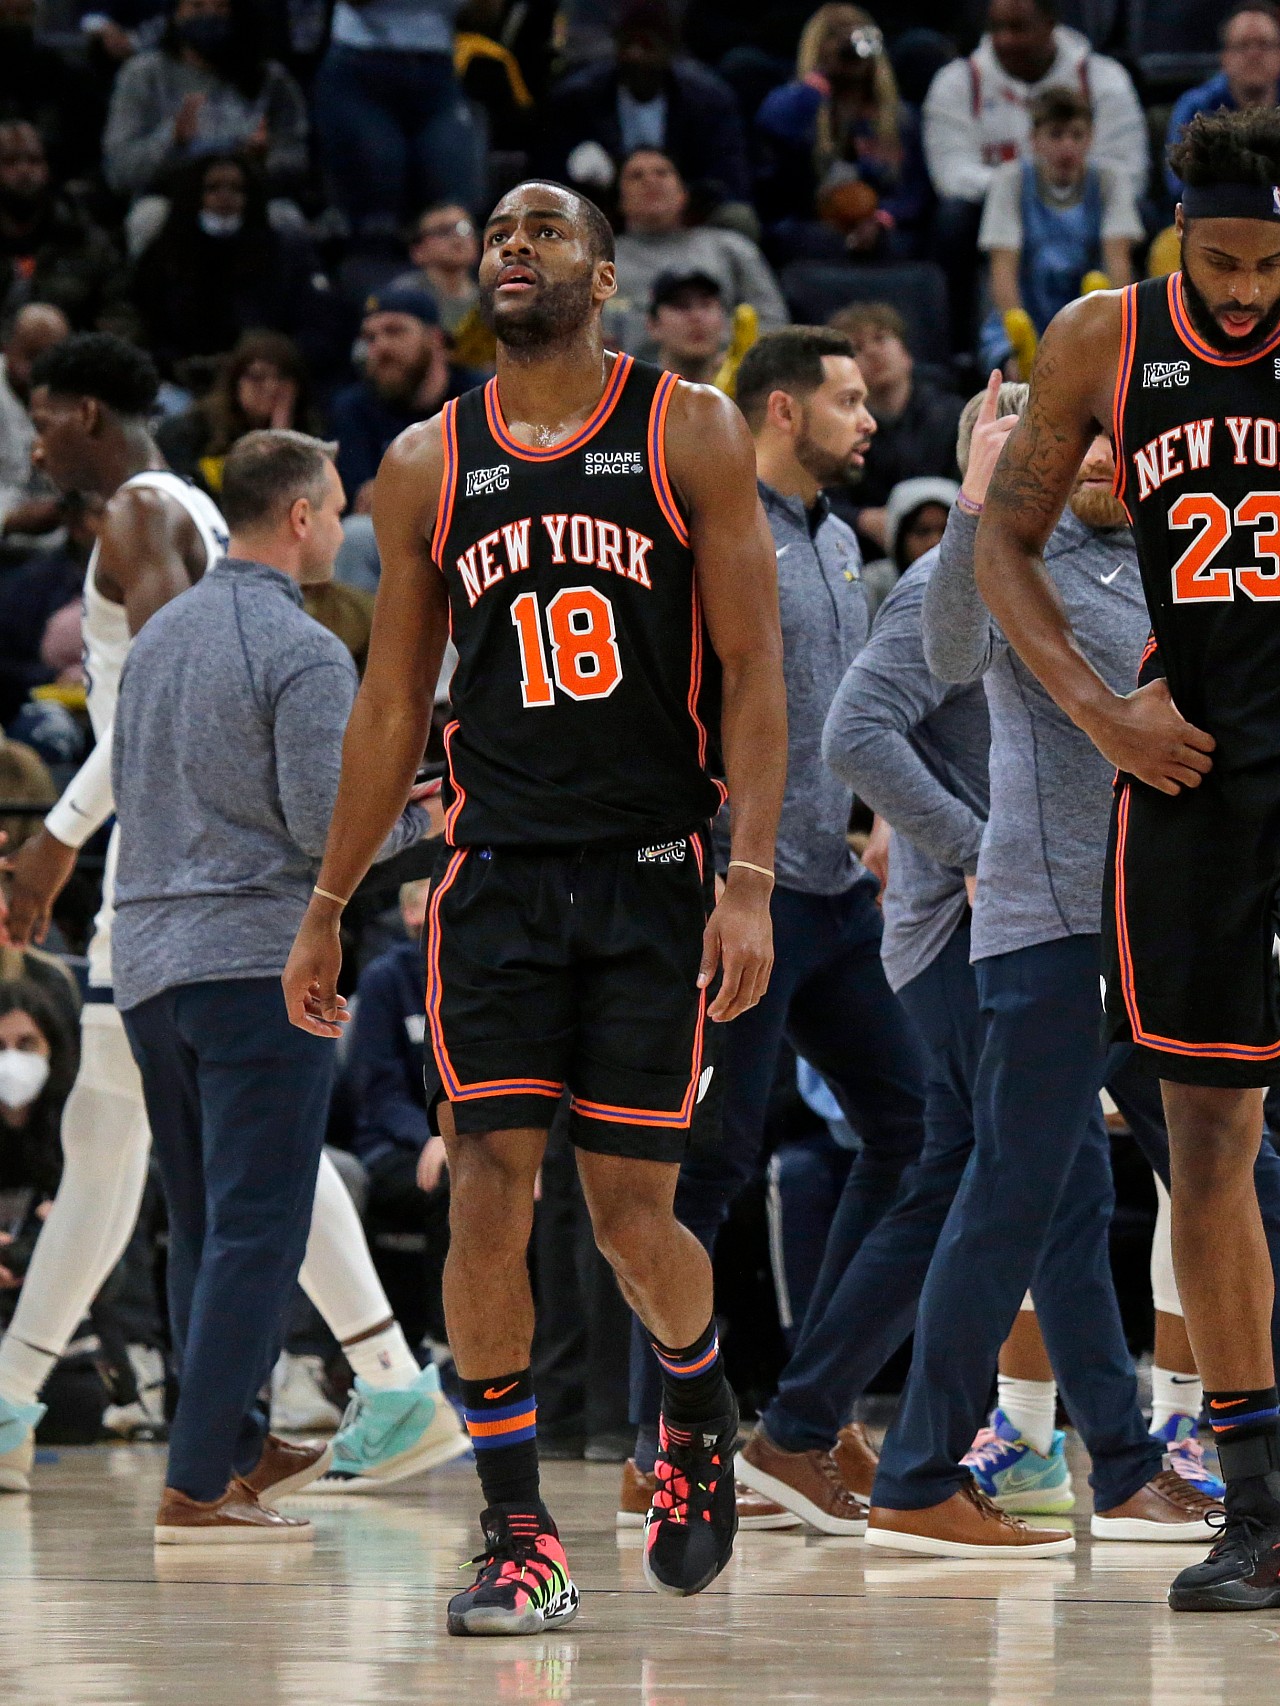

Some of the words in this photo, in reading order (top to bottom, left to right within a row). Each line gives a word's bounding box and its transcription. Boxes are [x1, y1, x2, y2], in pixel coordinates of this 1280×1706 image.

[585, 452, 641, 463] SQUARE
[585, 463, 630, 475] SPACE
[1133, 417, 1214, 502] NEW
[456, 517, 532, 608] NEW
[541, 514, 653, 590] YORK
[509, 585, 623, 708] 18
